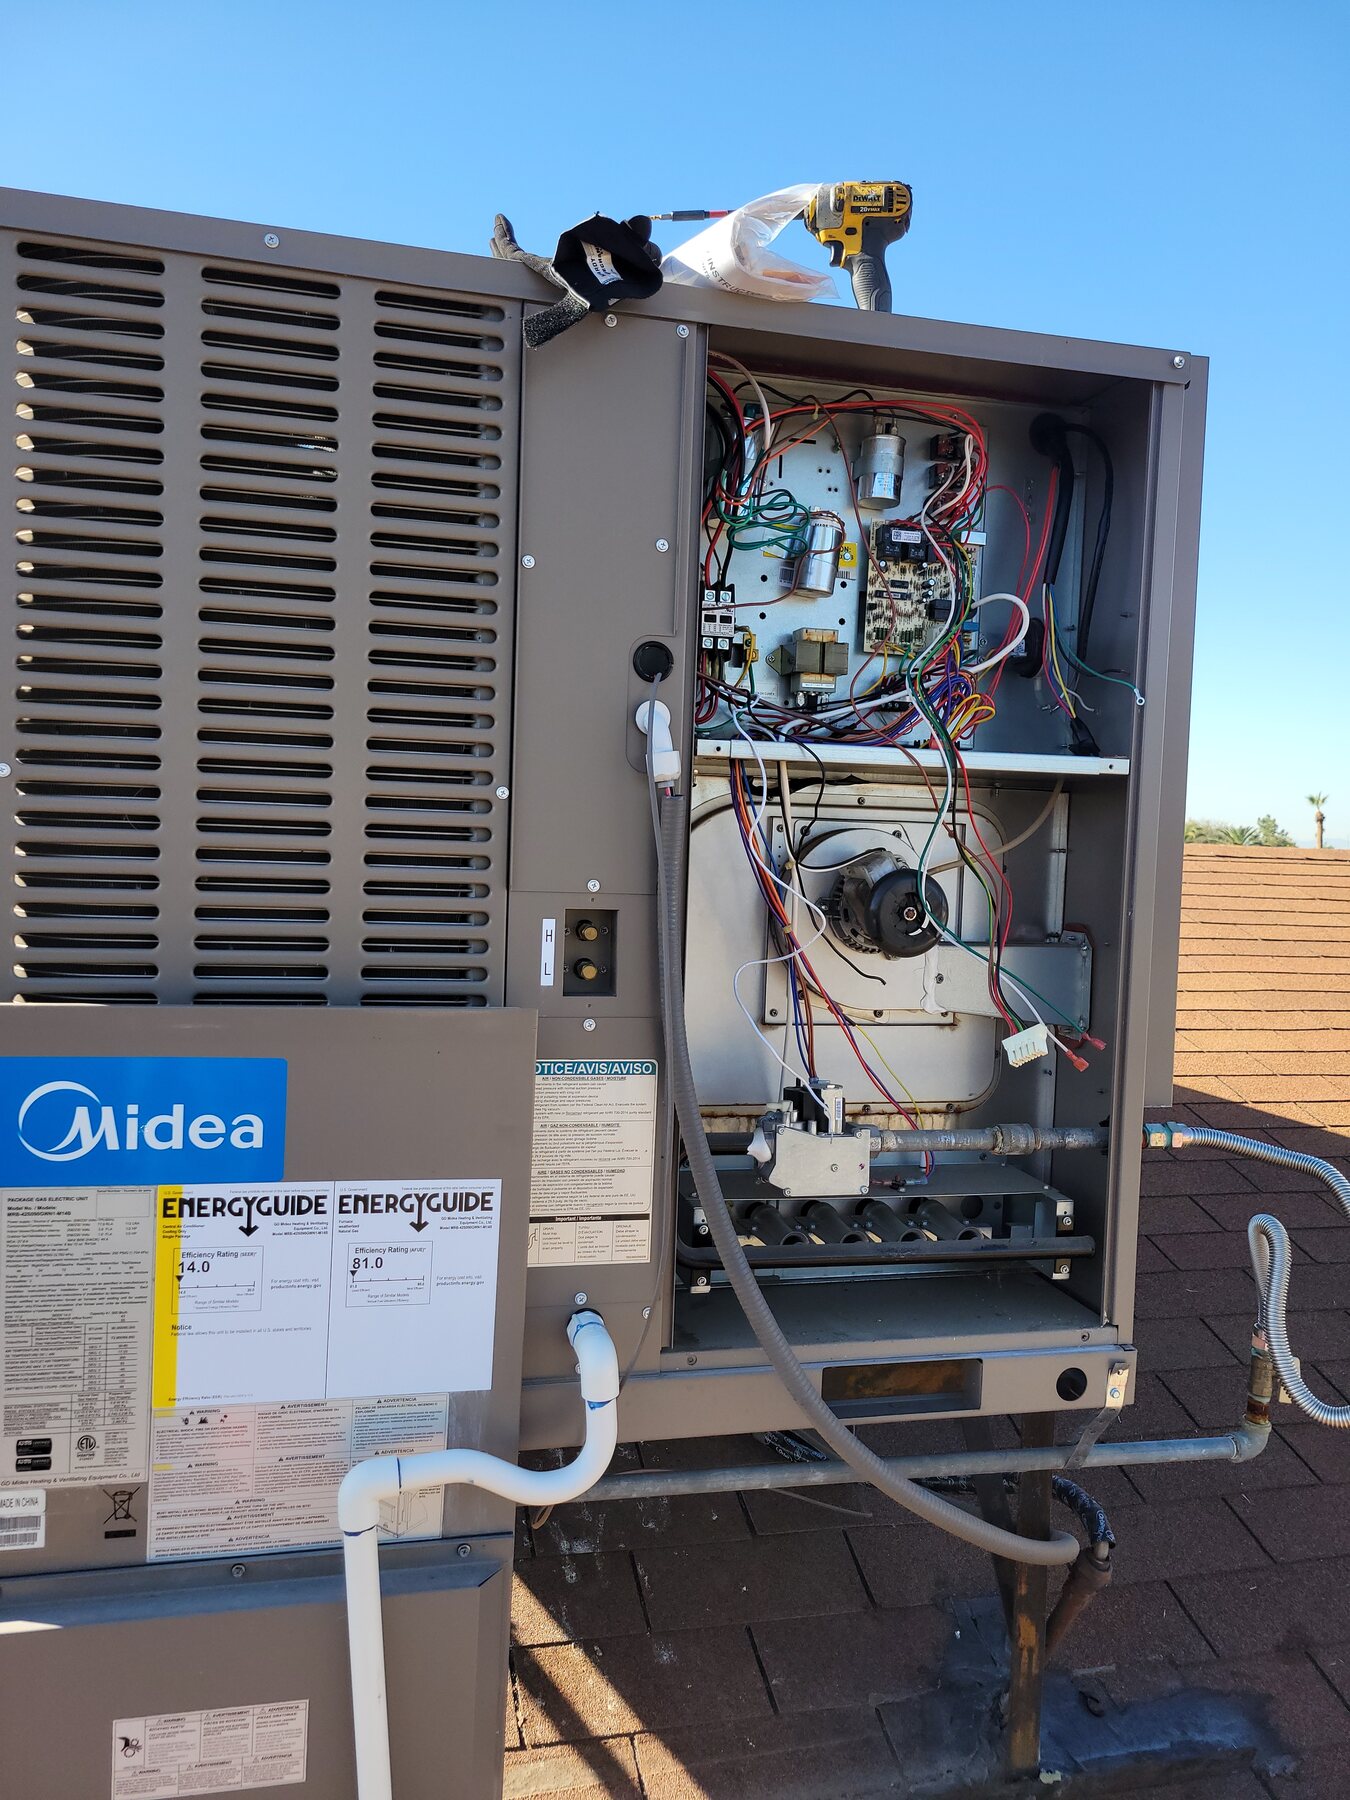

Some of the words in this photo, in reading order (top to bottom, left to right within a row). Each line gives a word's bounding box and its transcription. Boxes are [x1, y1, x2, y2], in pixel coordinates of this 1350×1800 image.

[545, 929, 553, 942] H
[544, 962, 552, 976] L
[536, 1062, 652, 1074] OTICE/AVIS/AVISO
[46, 1104, 264, 1152] Midea
[162, 1194, 328, 1220] ENERGYGUIDE
[338, 1192, 494, 1216] ENERGYGUIDE
[178, 1261, 210, 1273] 14.0
[352, 1257, 383, 1269] 81.0
